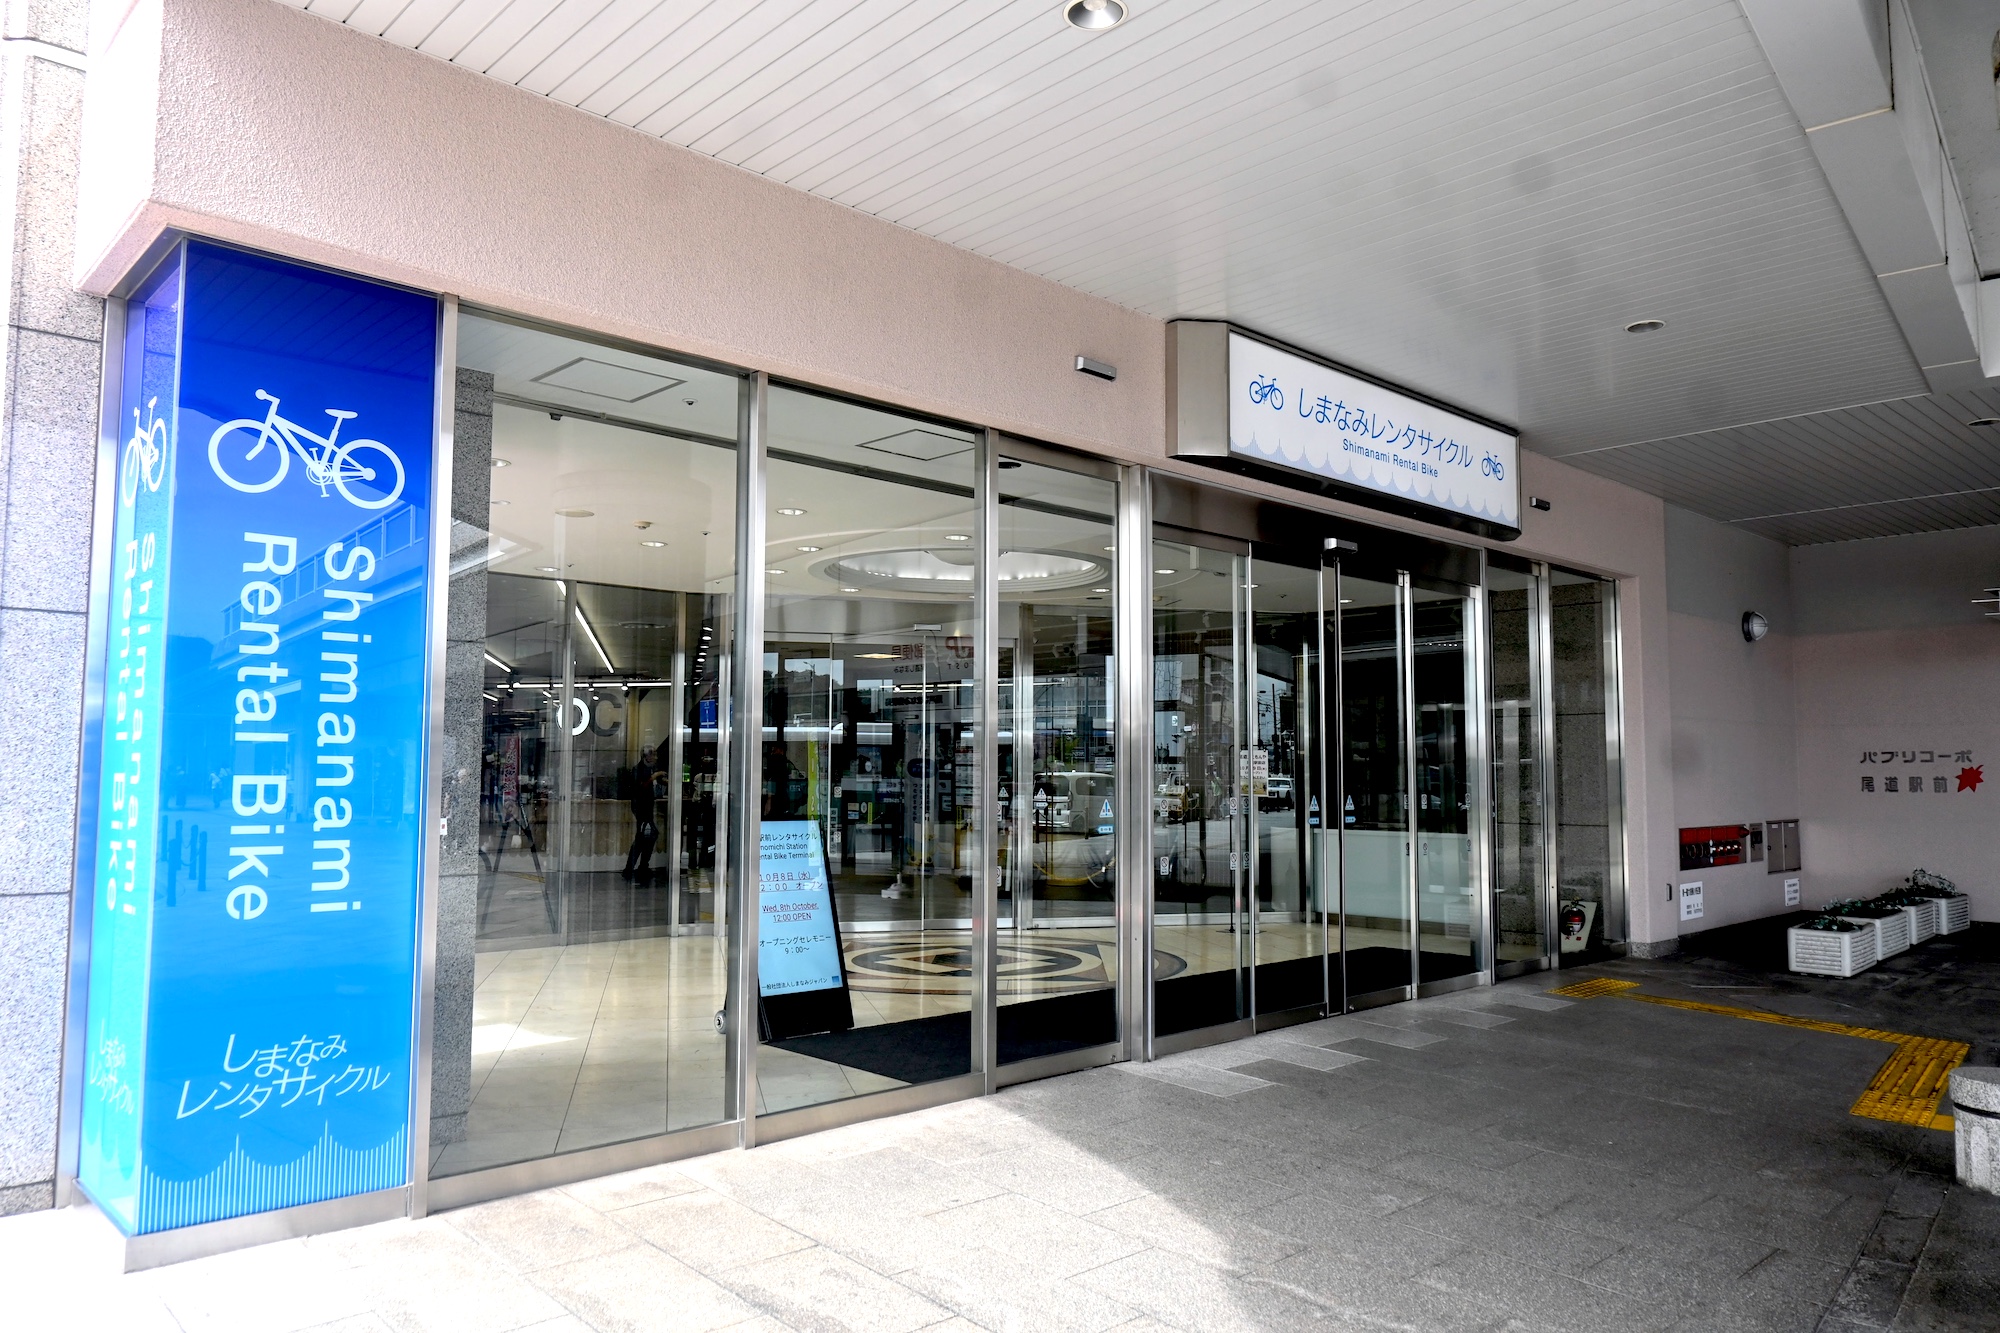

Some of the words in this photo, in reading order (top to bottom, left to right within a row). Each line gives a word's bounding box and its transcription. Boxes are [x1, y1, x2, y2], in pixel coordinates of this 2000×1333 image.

[1299, 388, 1474, 468] しまなみレンタサイクル
[1342, 438, 1390, 463] Shimanami
[1393, 454, 1419, 472] Rental
[1421, 462, 1439, 478] Bike
[234, 531, 298, 743] Rental
[310, 541, 377, 913] Shimanami
[1860, 749, 1973, 764] パブリコーポ
[1861, 776, 1948, 793] 尾道駅前
[225, 774, 287, 921] Bike
[773, 852, 788, 860] Bike
[788, 851, 815, 859] Terminal
[786, 842, 808, 850] Station
[773, 913, 791, 922] 12:00
[792, 912, 812, 920] OPEN
[780, 903, 791, 911] 8th
[760, 935, 832, 947] オープニングセレモニー
[223, 1033, 348, 1078] しまなみ
[176, 1064, 391, 1119] レンタサイクル
